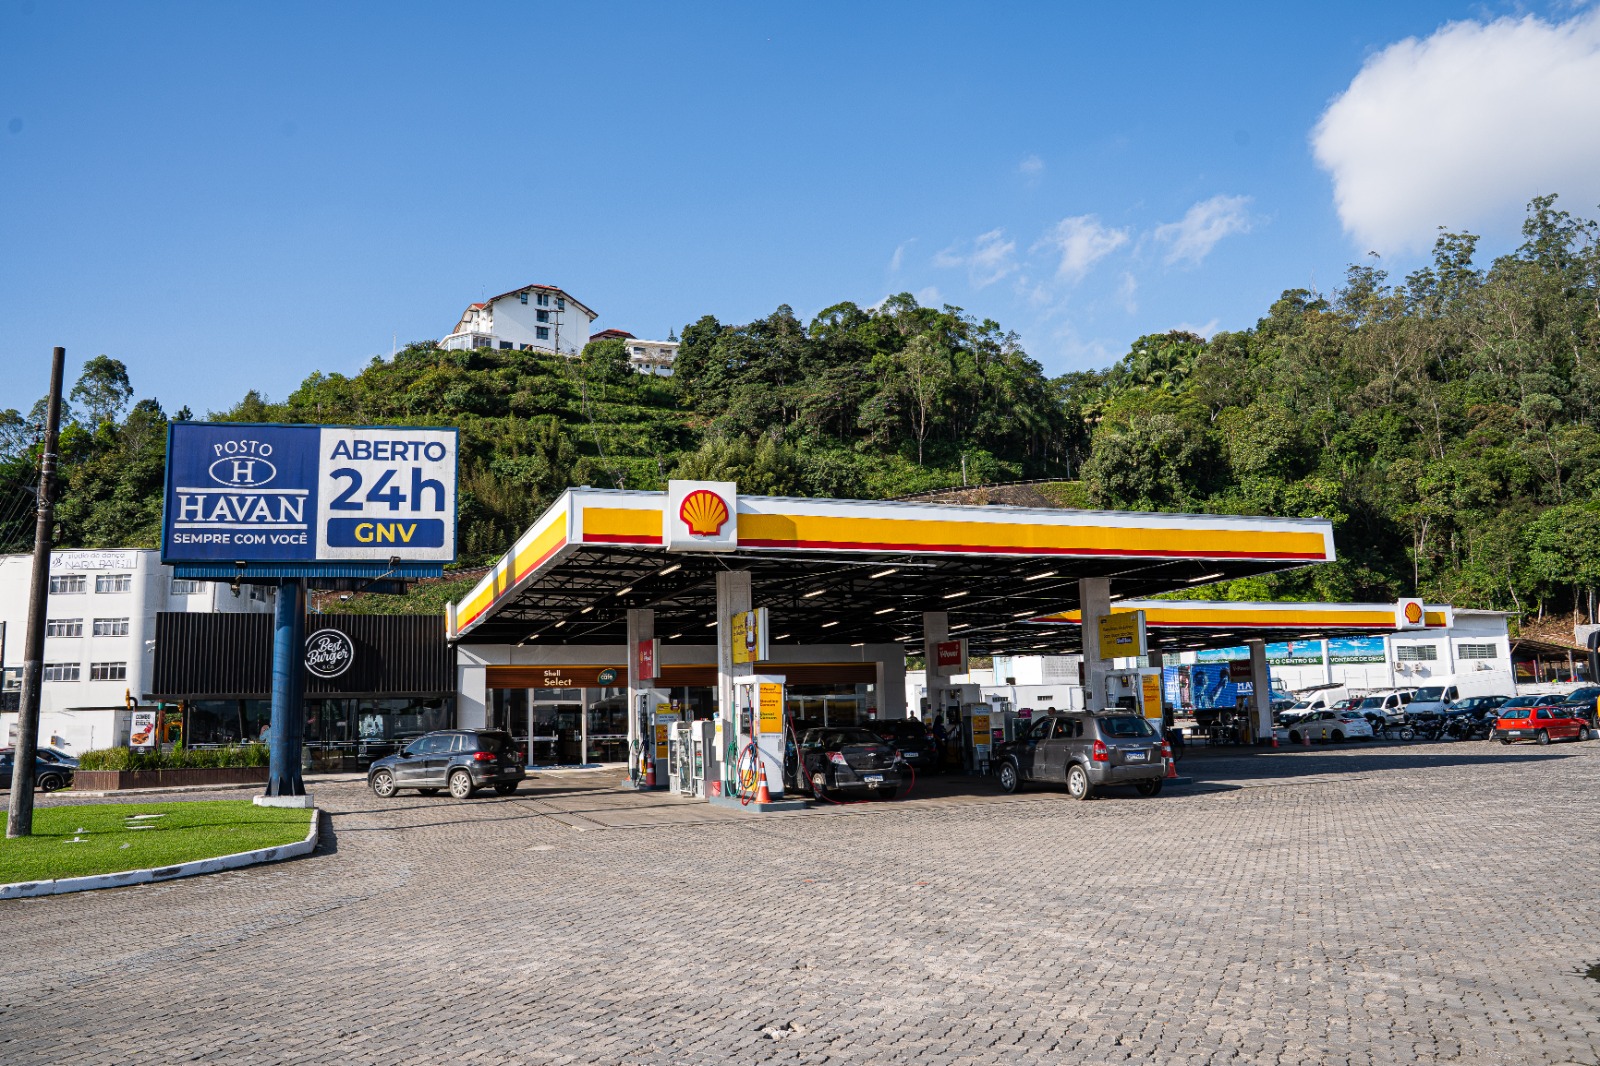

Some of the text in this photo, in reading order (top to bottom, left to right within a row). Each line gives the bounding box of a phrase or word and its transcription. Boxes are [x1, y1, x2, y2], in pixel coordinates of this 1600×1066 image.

[214, 440, 273, 456] POSTO
[330, 440, 447, 462] ABERTO
[231, 461, 256, 482] H
[329, 467, 446, 512] 24h
[177, 495, 307, 522] HAVAN
[173, 532, 308, 544] SEMPRE COM VOCÊ
[354, 523, 418, 543] GNV
[317, 637, 342, 652] Best
[307, 649, 349, 665] Burger
[939, 650, 958, 658] V-Power
[543, 669, 561, 677] Shell
[544, 677, 572, 686] Select
